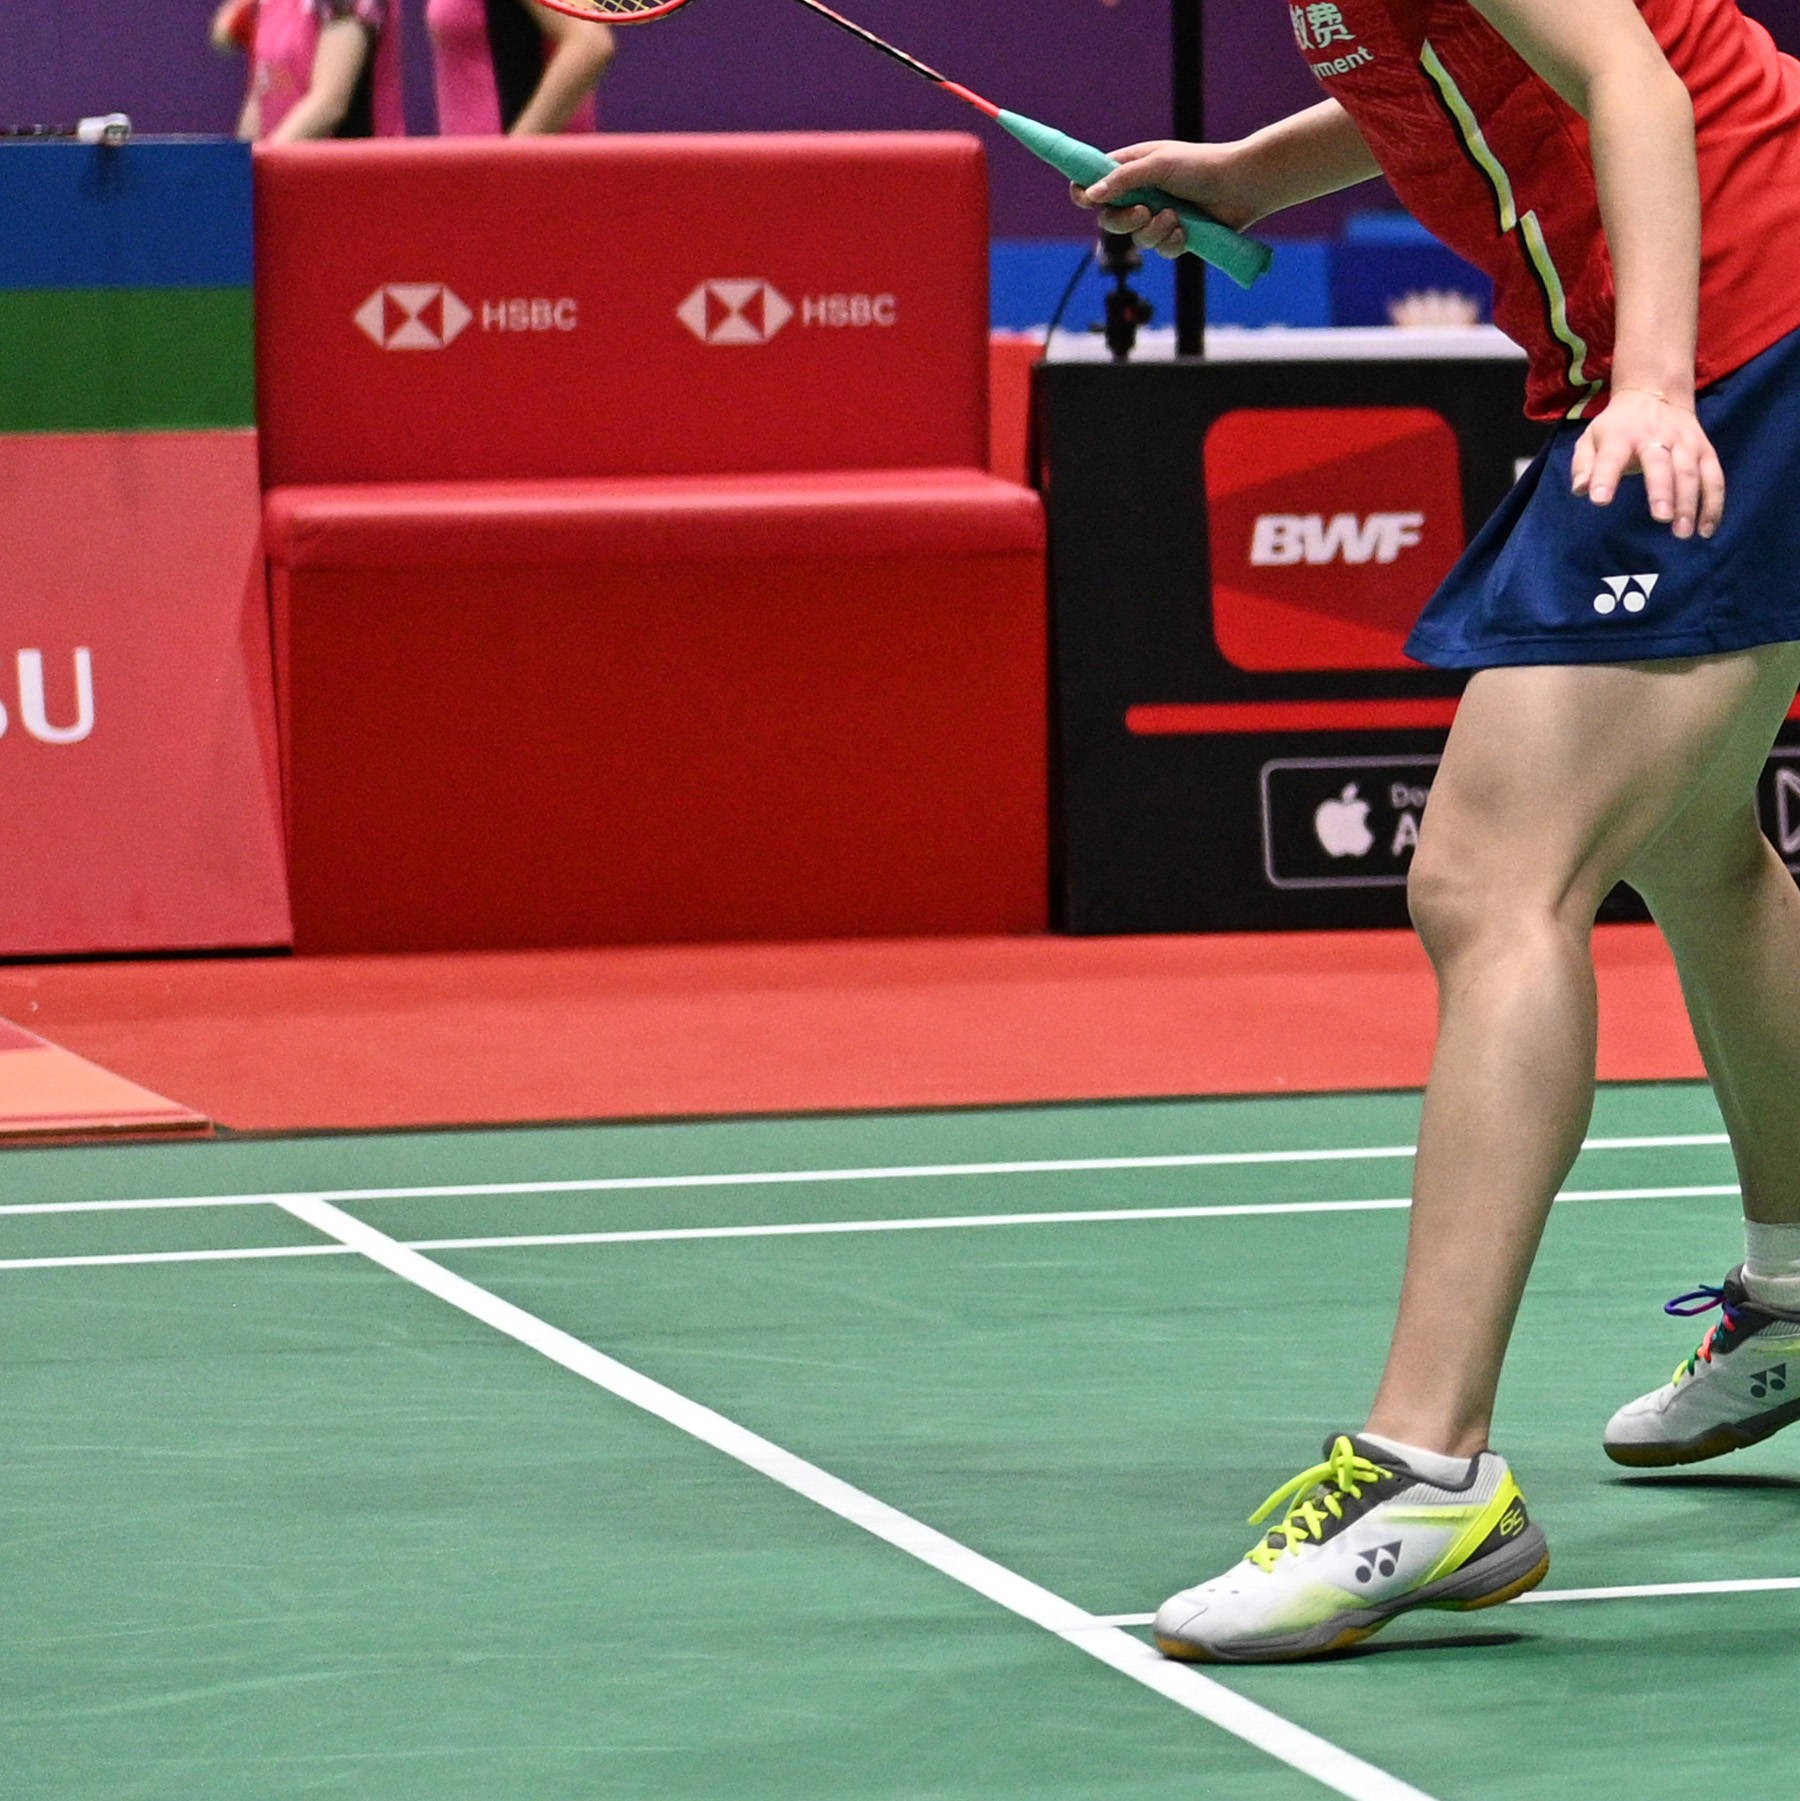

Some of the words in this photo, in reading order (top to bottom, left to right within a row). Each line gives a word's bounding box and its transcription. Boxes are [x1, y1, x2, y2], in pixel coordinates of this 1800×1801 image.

[481, 300, 578, 331] HSBC
[803, 294, 897, 326] HSBC
[1251, 512, 1425, 565] BWF
